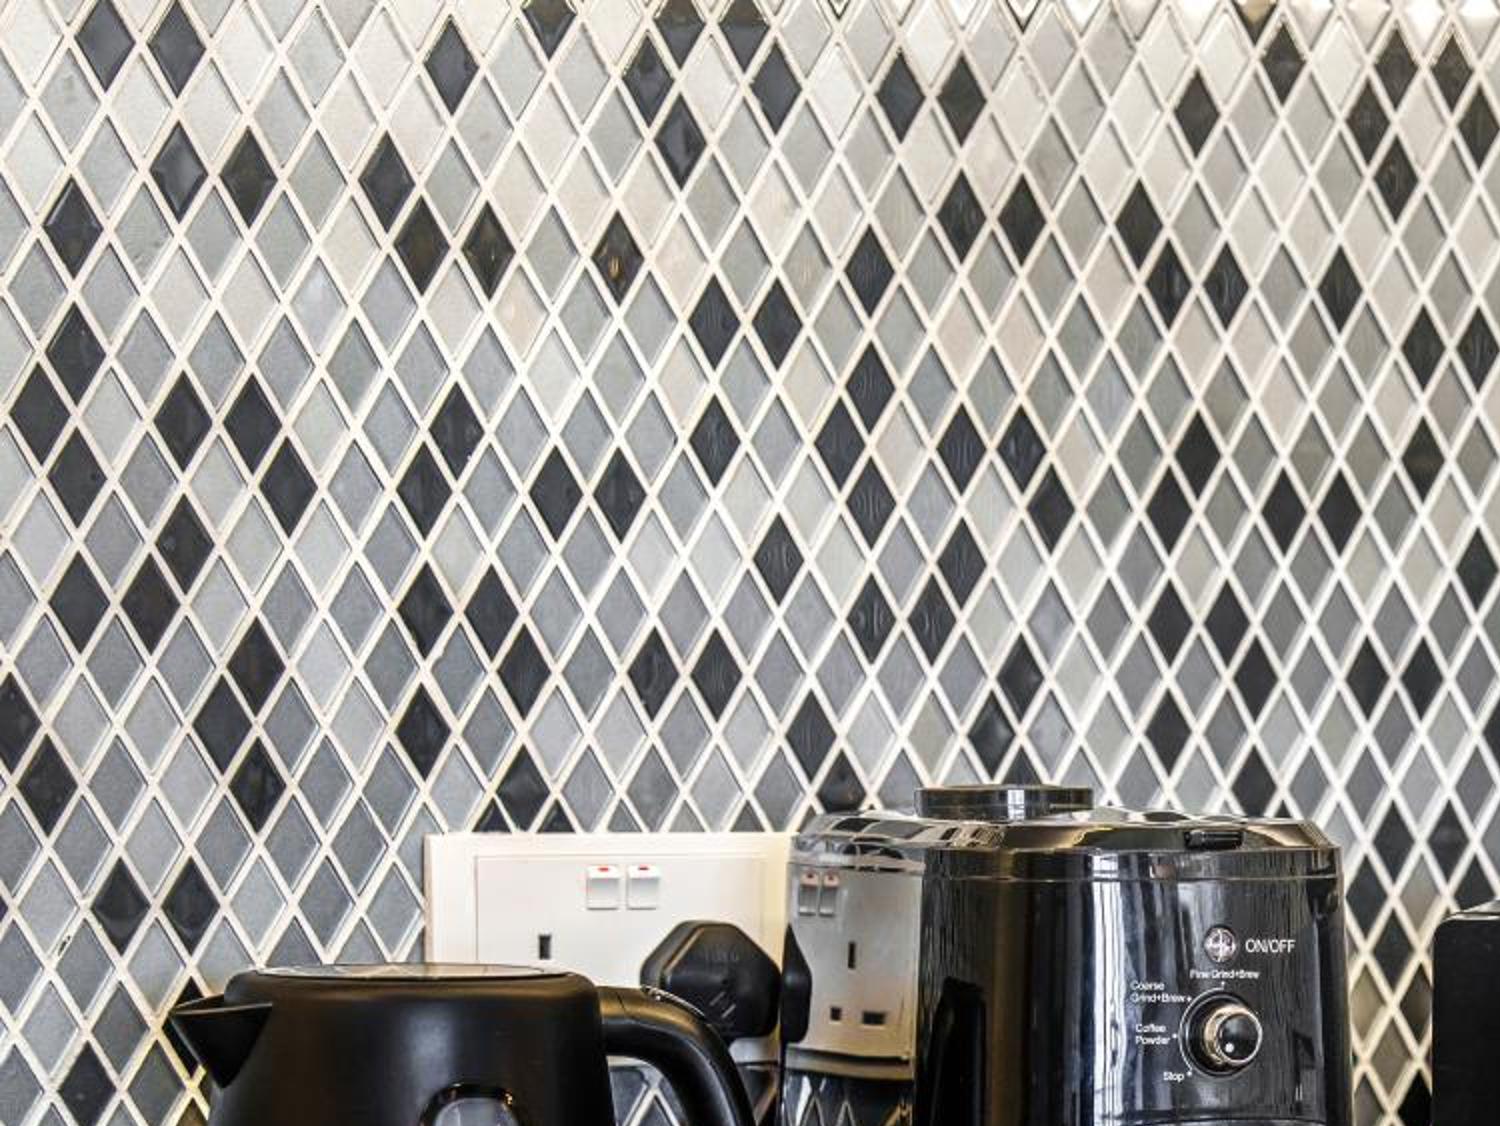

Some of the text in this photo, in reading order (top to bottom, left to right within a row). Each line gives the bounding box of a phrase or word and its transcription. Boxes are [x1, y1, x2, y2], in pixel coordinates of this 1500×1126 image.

[1245, 939, 1297, 954] ON/OFF
[1130, 981, 1165, 991] Coarse
[1136, 1024, 1167, 1033] Coffee
[1136, 1035, 1170, 1045] Powder
[1163, 1072, 1184, 1083] Stop
